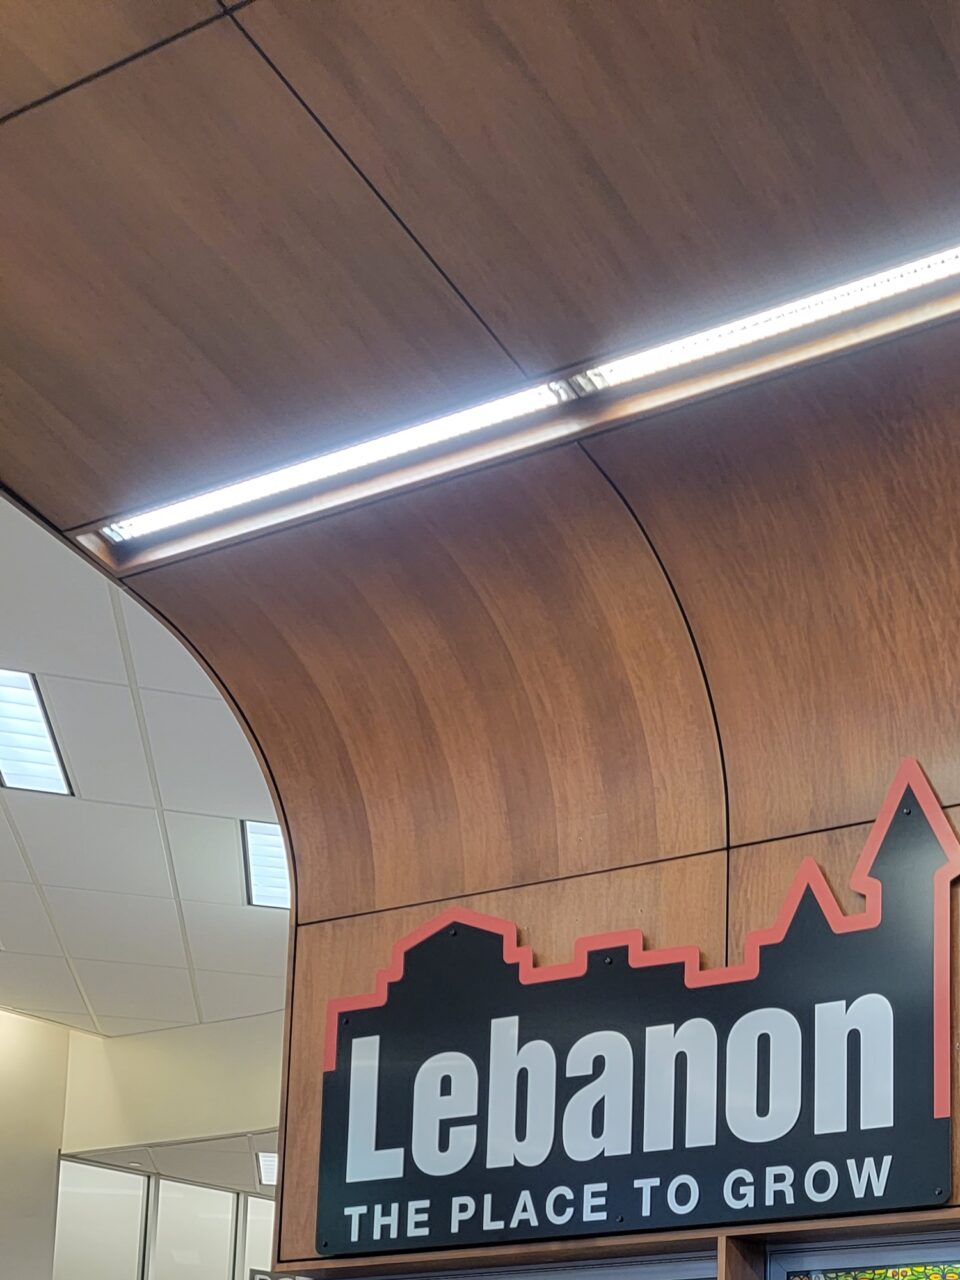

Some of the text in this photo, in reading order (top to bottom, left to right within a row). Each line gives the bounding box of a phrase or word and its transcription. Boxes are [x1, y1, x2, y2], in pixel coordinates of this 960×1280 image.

[345, 992, 895, 1184] Lebanon
[343, 1154, 894, 1243] THE PLACE TO GROW
